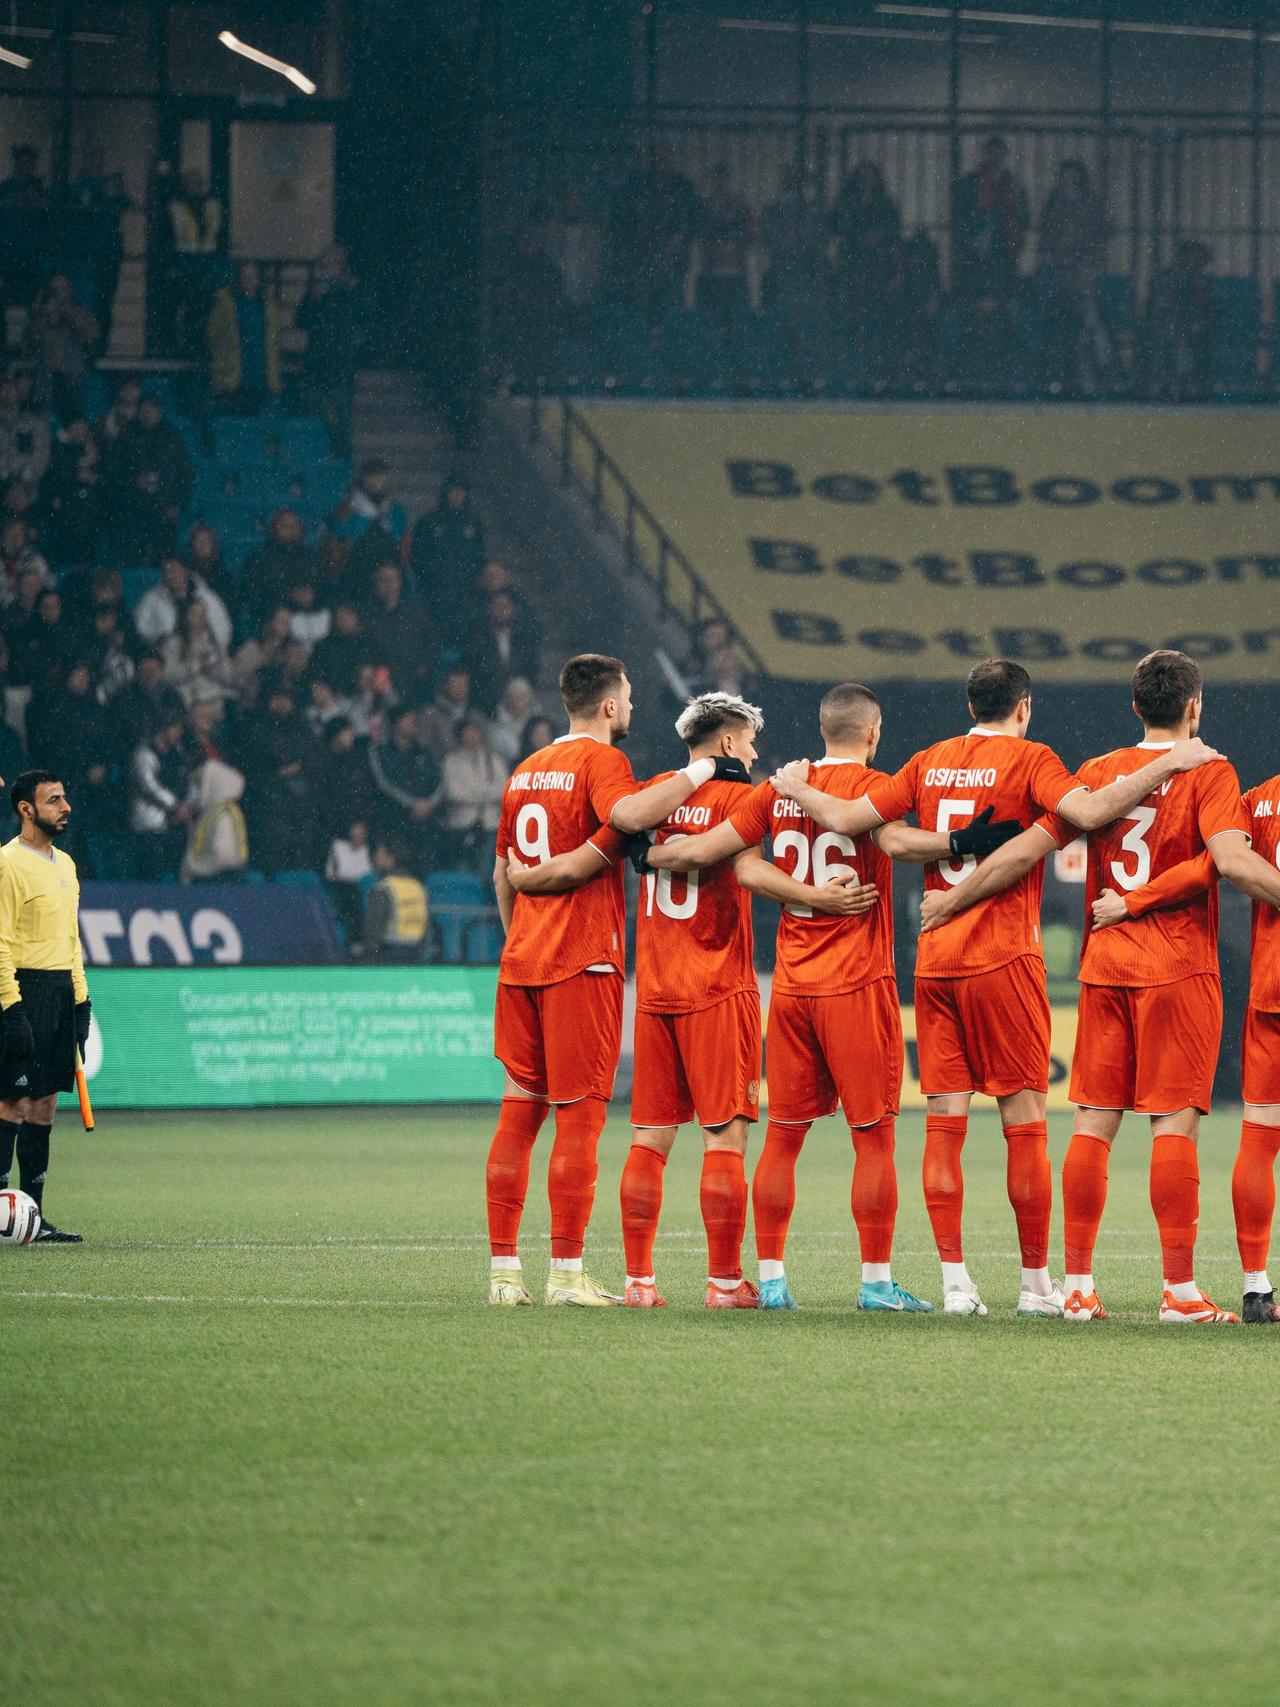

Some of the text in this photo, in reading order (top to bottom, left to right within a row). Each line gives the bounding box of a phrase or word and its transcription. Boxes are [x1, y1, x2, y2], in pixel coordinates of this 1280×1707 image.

[516, 803, 552, 870] 9
[936, 798, 978, 886] 5
[1110, 805, 1157, 891] 3
[1254, 799, 1273, 818] AN.
[773, 829, 861, 917] 26
